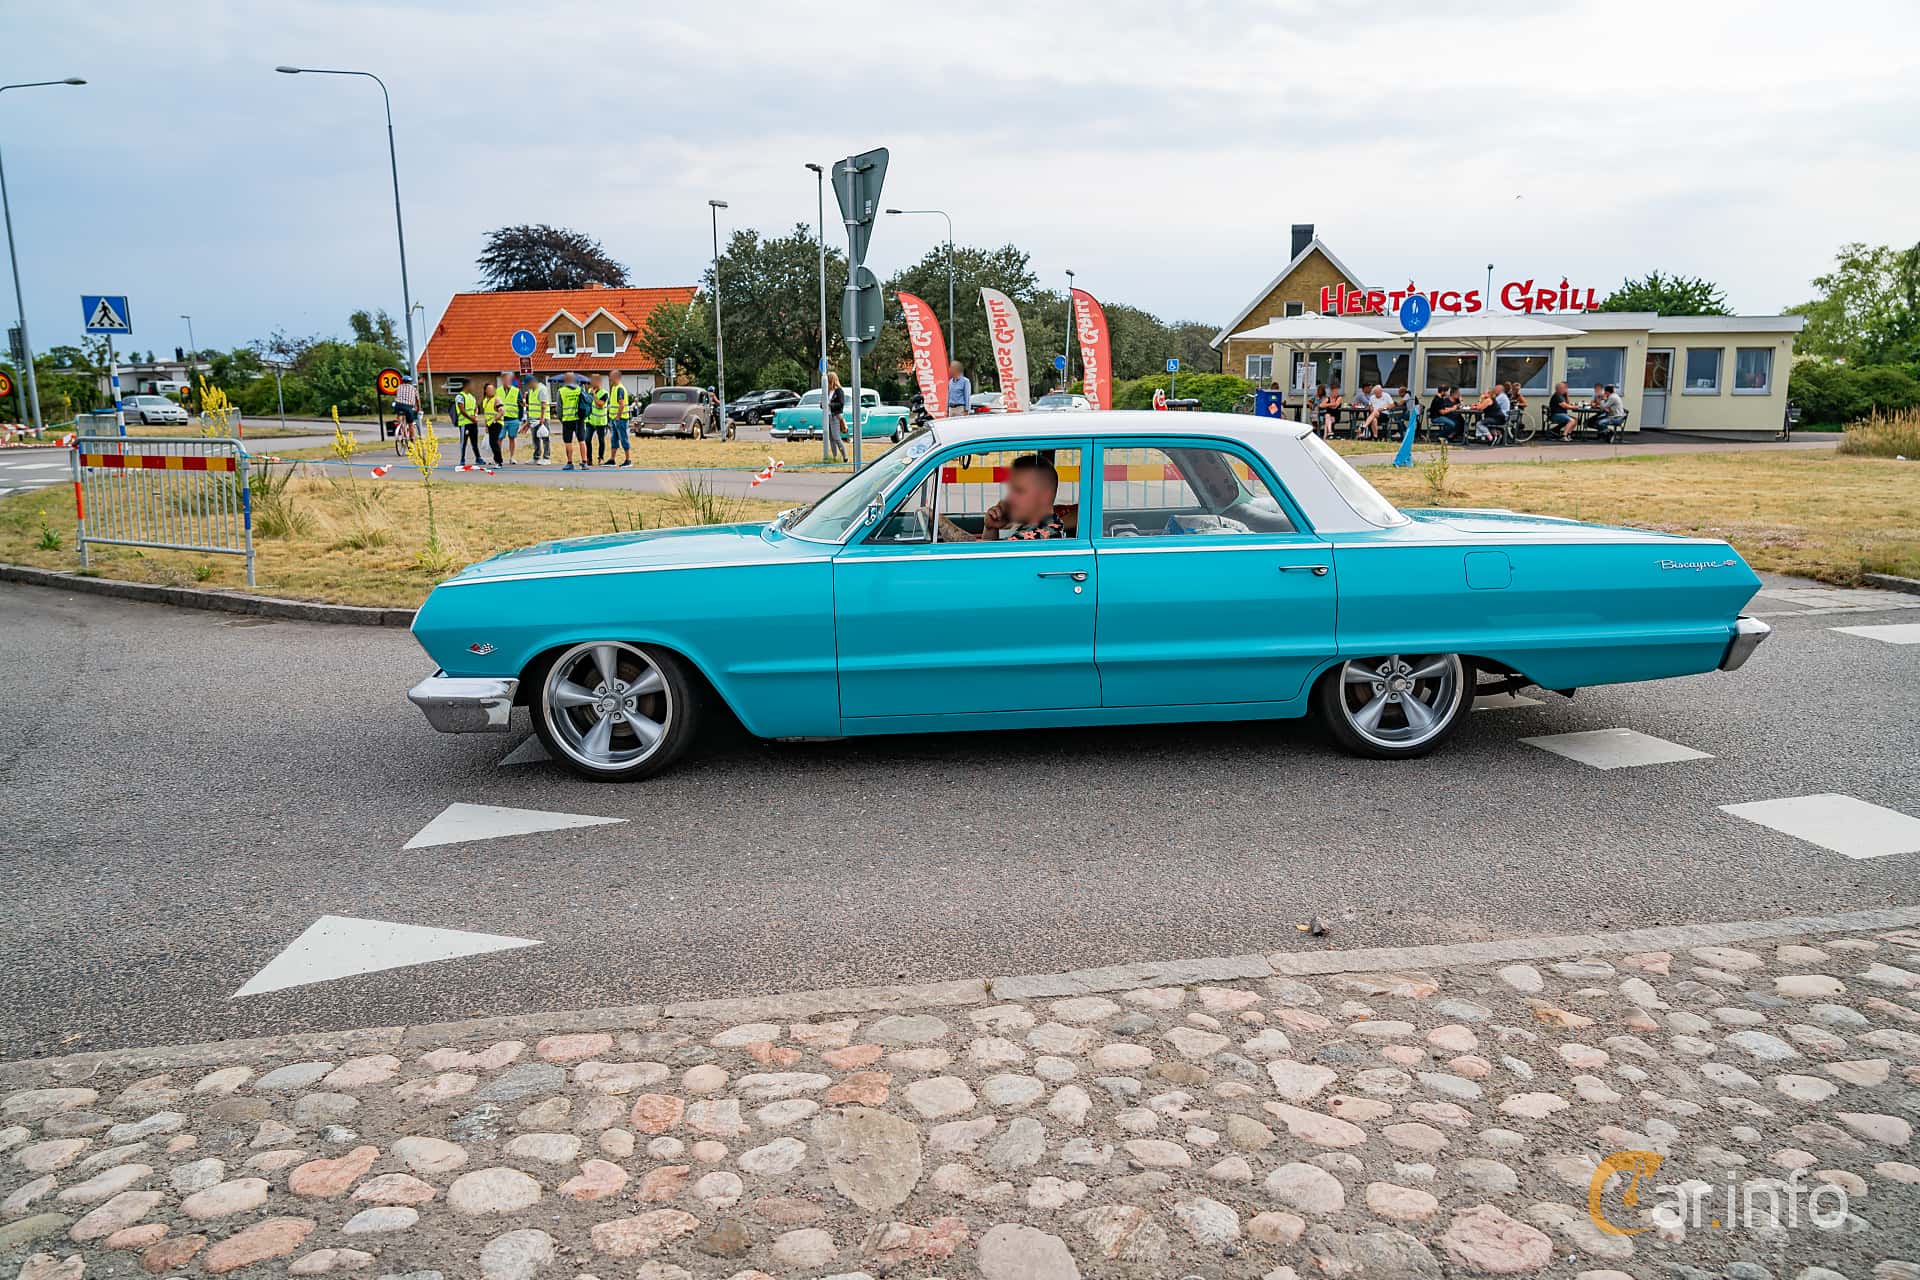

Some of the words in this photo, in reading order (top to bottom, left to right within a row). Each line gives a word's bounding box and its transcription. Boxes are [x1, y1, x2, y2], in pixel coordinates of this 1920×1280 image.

[1319, 281, 1482, 317] HERTGS
[383, 376, 399, 389] 30
[1654, 559, 1720, 573] Biscayne
